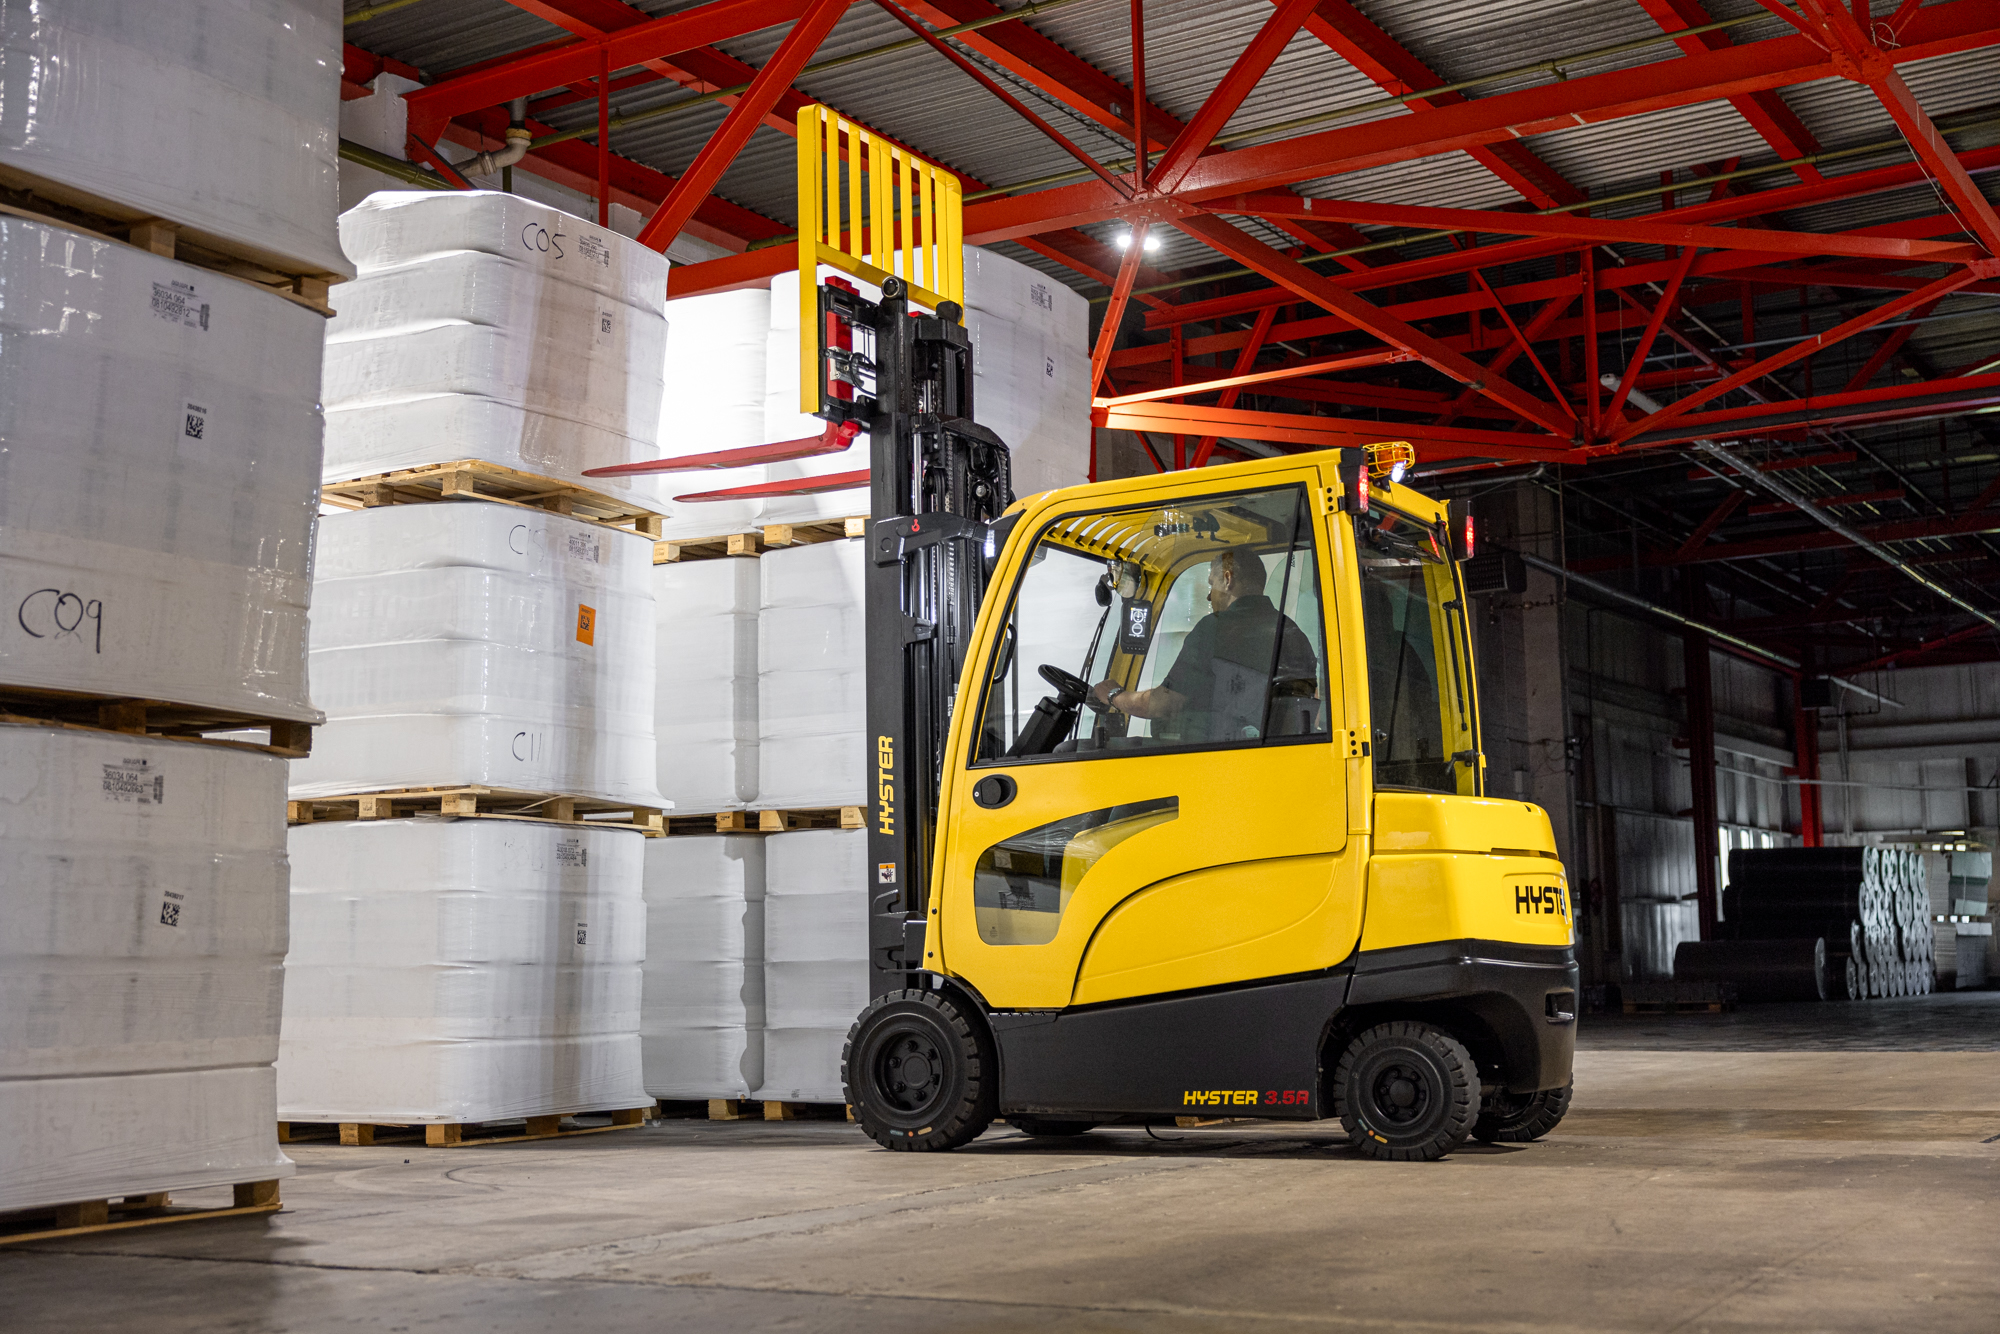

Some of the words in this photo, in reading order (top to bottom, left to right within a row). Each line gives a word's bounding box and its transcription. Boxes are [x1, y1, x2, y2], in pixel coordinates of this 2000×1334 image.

[521, 222, 567, 260] C05
[511, 731, 542, 762] C11
[878, 735, 895, 836] HYSTER
[1183, 1090, 1259, 1106] HYSTER
